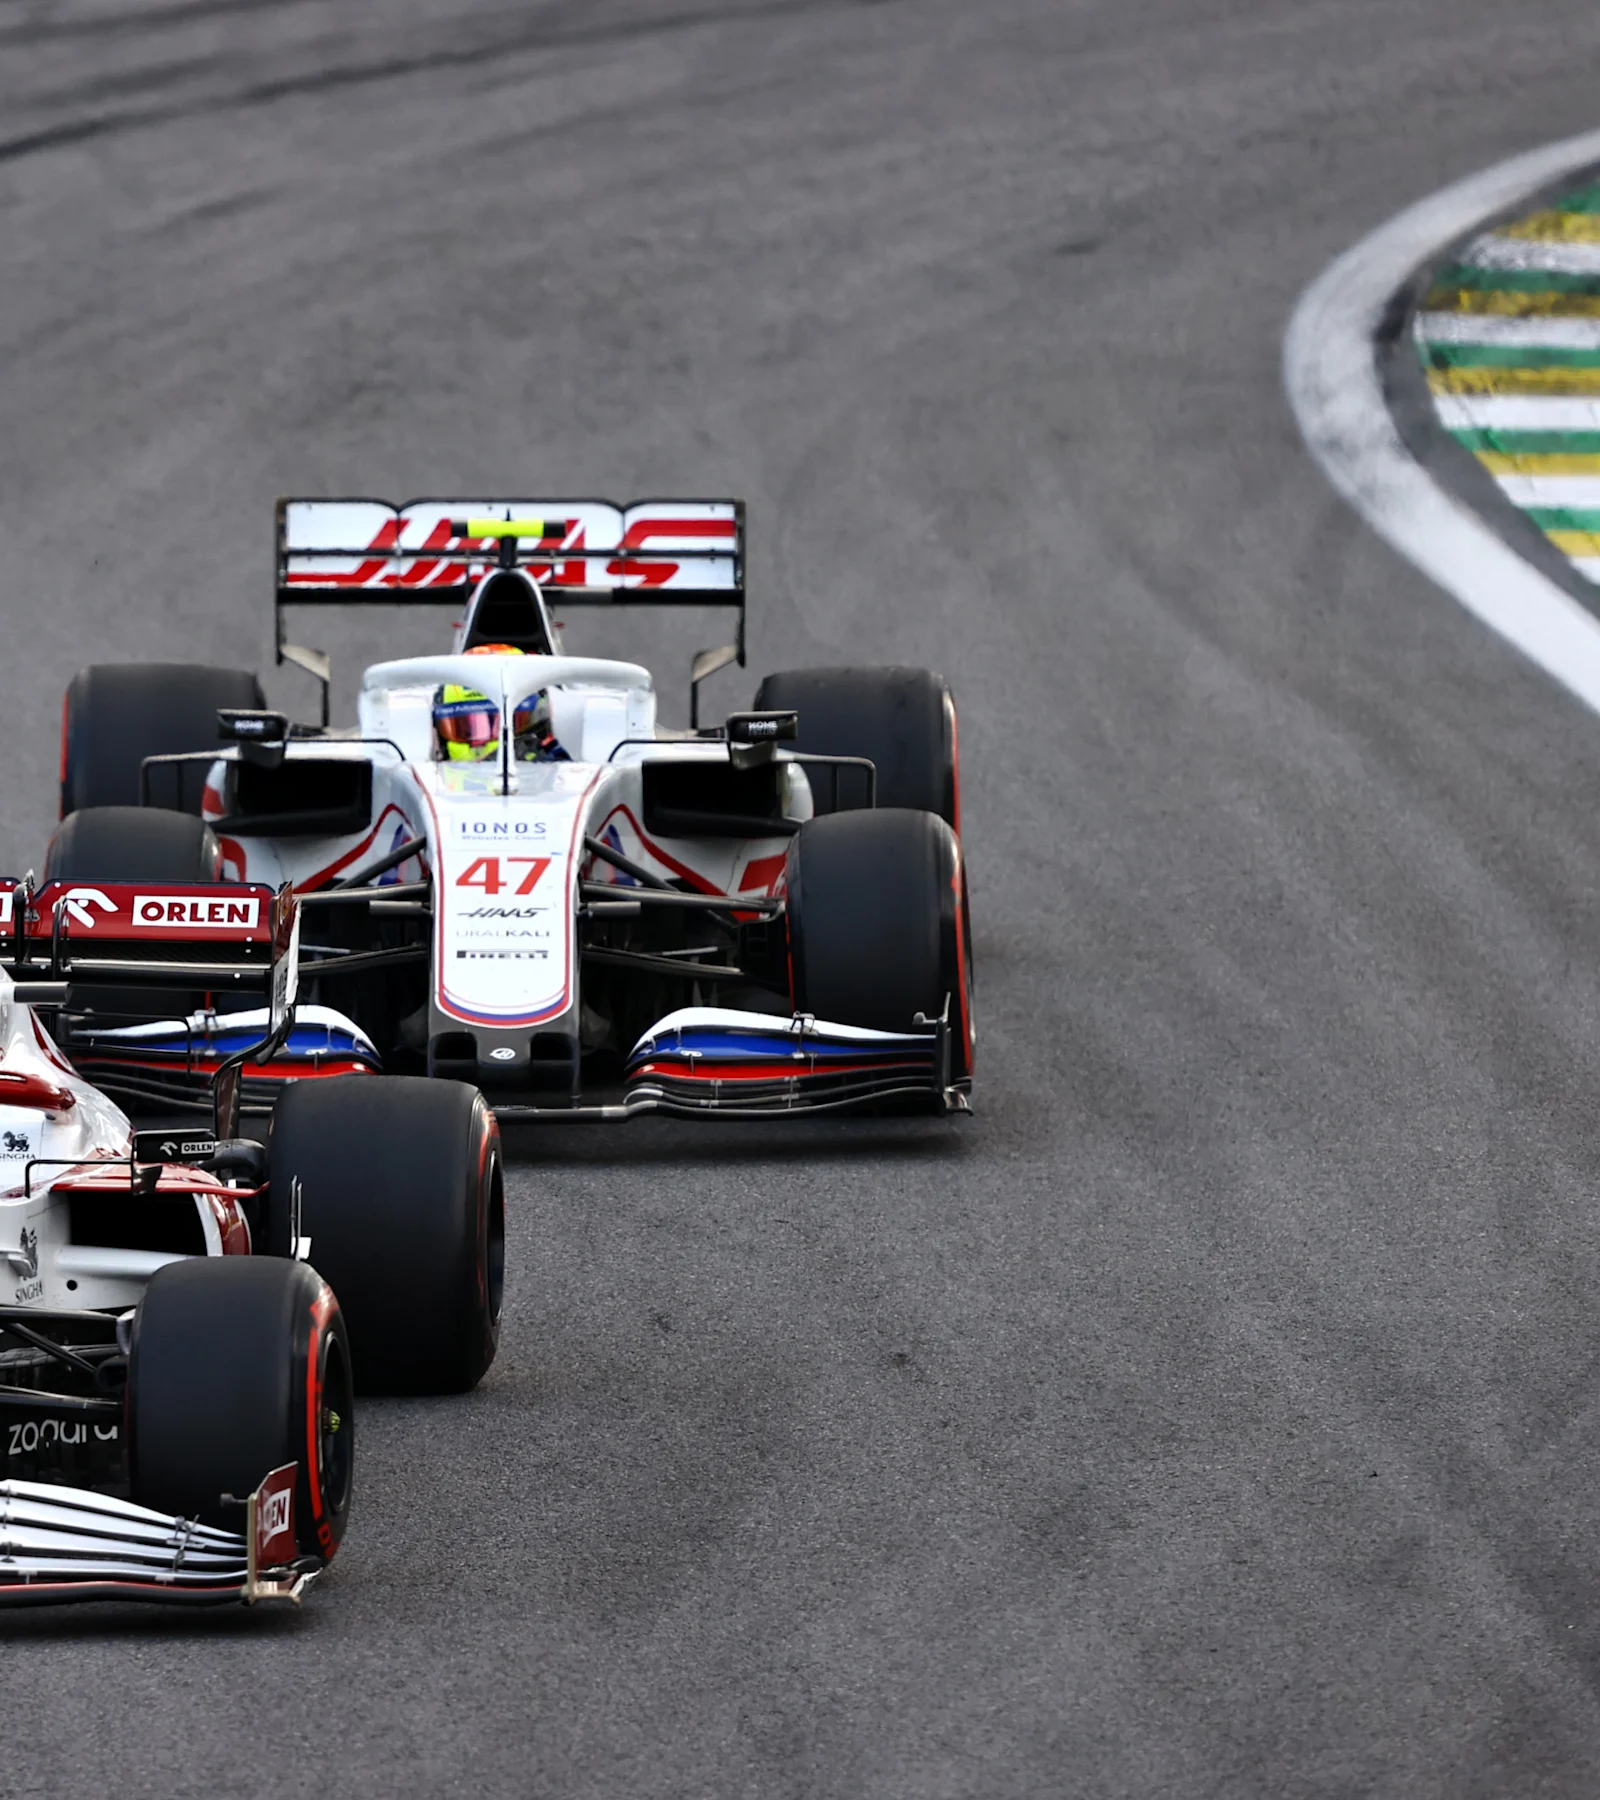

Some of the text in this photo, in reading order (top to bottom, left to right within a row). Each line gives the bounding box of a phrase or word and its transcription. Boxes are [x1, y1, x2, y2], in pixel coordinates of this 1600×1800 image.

[461, 822, 547, 834] IONOS
[456, 857, 552, 895] 47
[140, 901, 250, 923] ORLEN
[457, 907, 550, 918] HAAS
[183, 1143, 212, 1152] ORLEN
[15, 1280, 43, 1302] SINGHA
